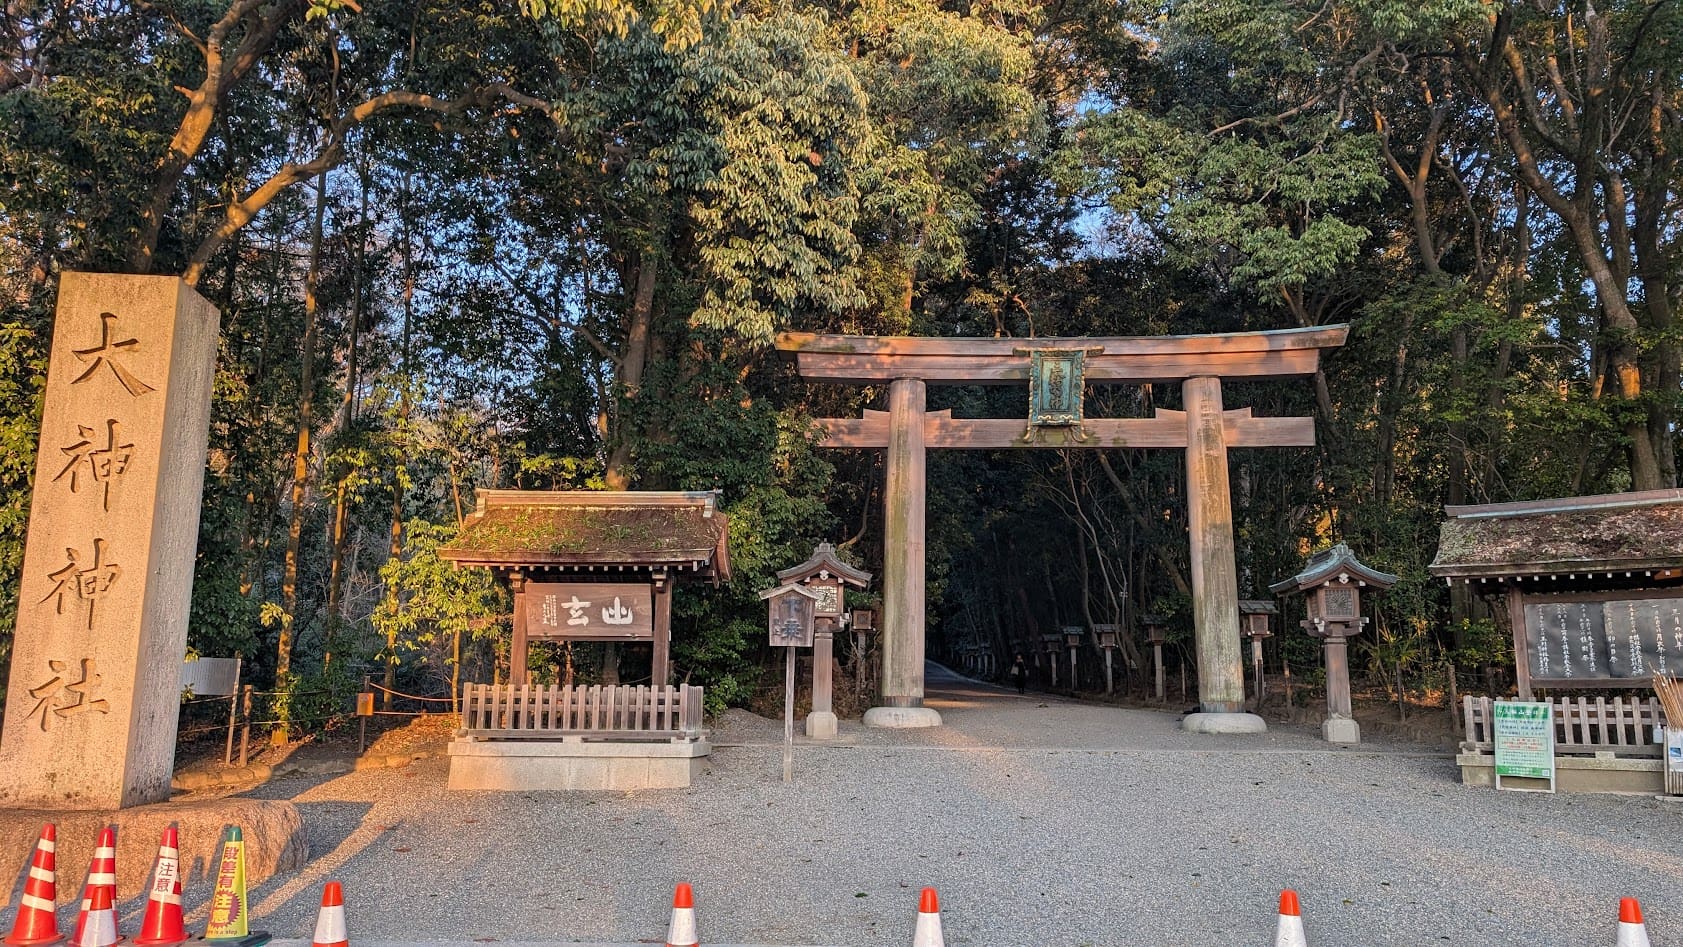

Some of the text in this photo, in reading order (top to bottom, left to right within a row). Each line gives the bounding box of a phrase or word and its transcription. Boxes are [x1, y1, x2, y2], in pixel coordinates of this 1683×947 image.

[27, 312, 156, 732] 大神神社
[154, 862, 174, 892] 注意
